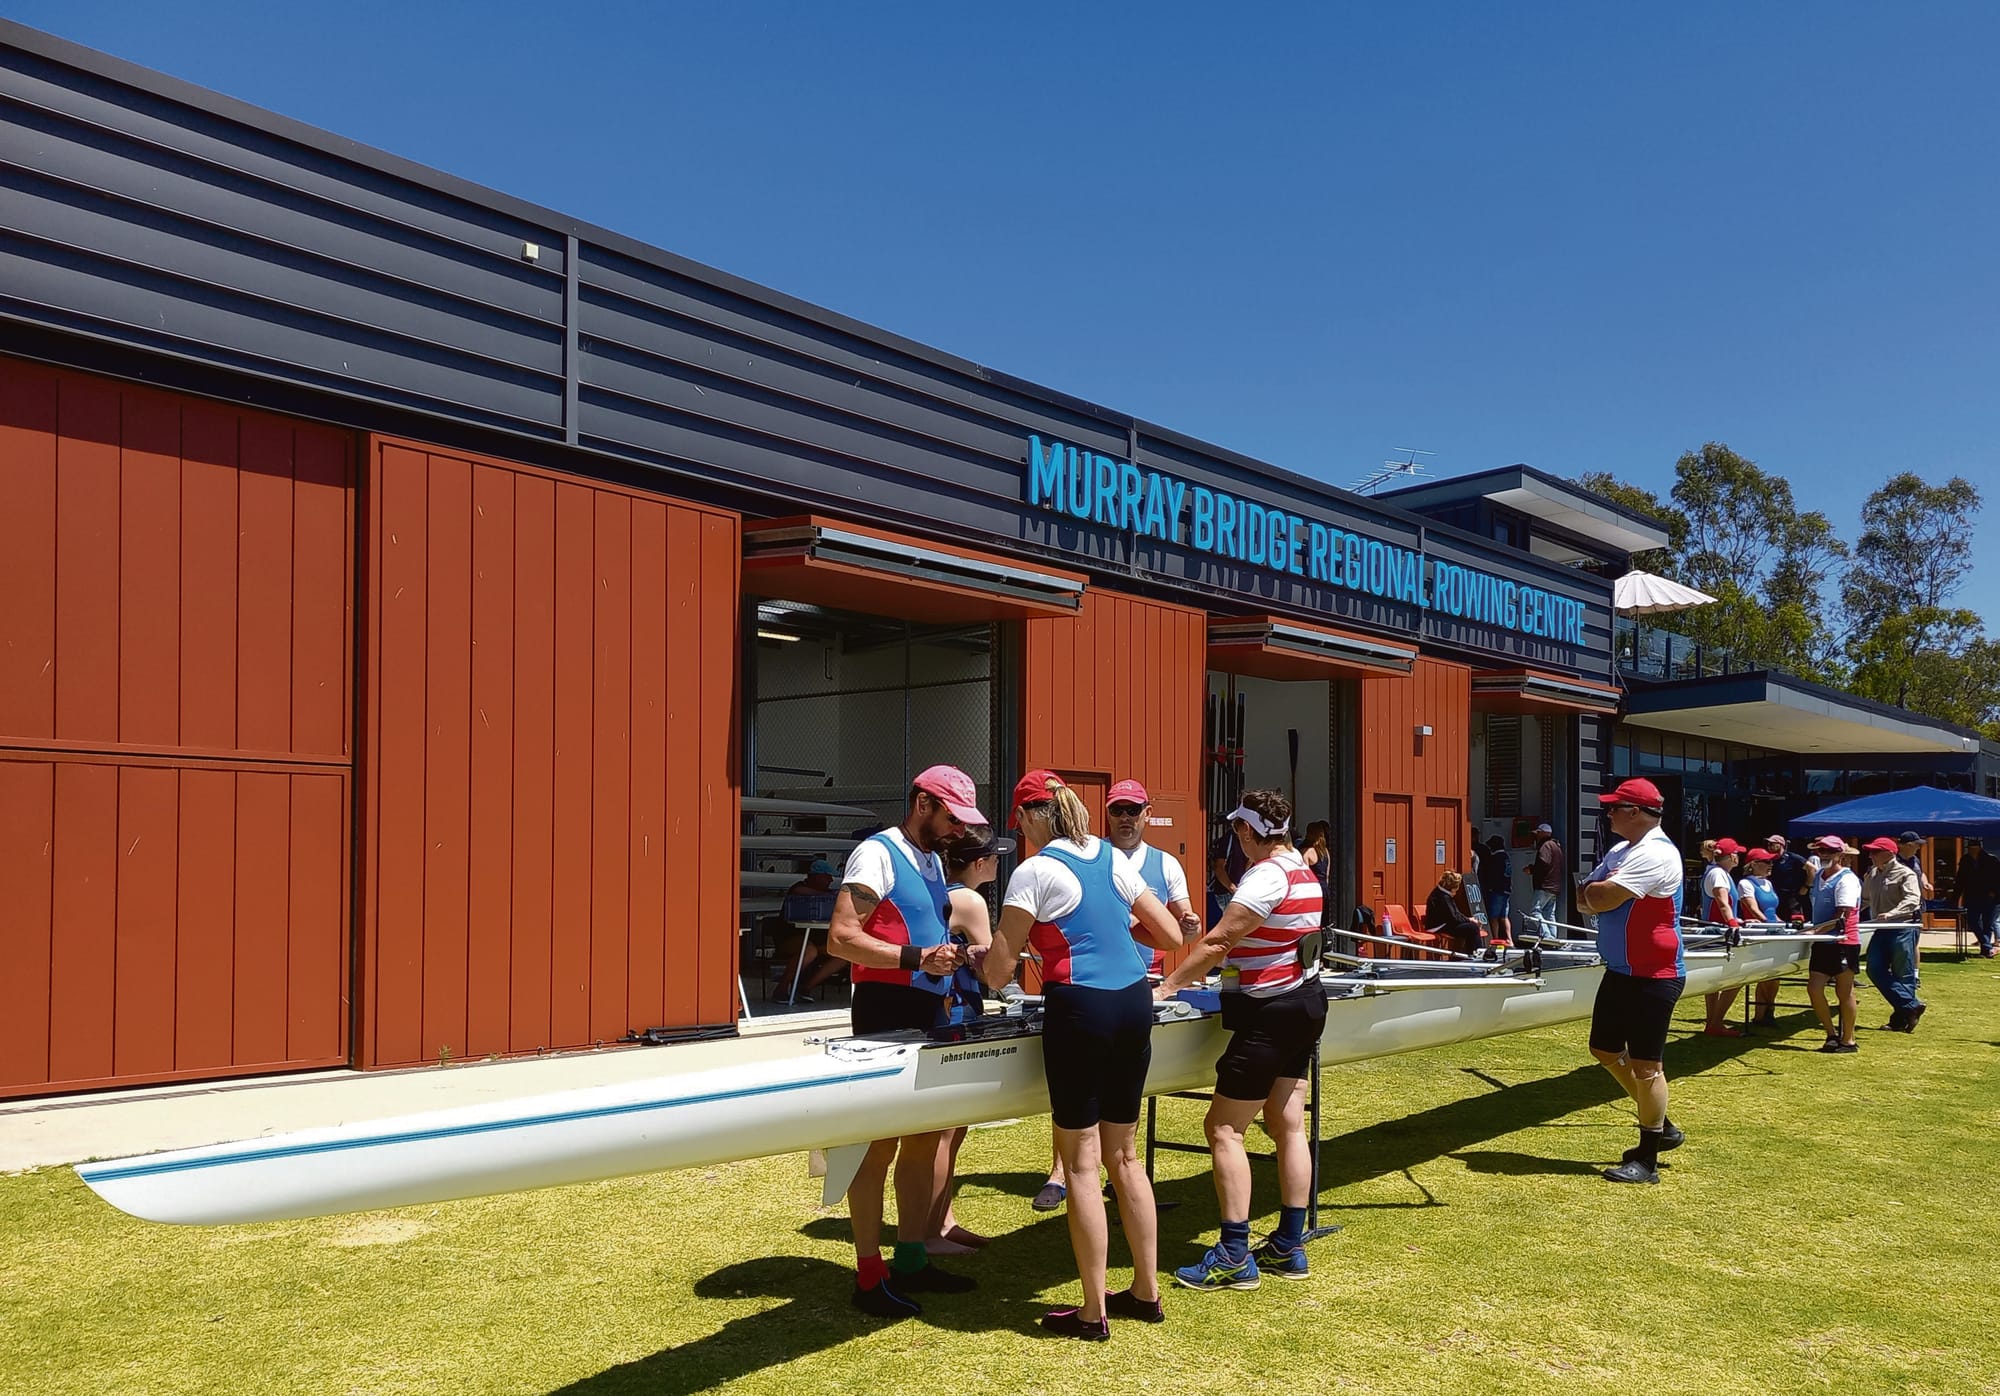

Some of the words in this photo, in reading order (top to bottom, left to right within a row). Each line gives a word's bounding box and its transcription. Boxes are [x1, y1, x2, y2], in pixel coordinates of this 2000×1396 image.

[1028, 435, 1185, 543] MURRAY
[1192, 486, 1303, 575] BRIDGE
[1308, 522, 1430, 607] REGIONAL
[1433, 560, 1517, 630] ROWING
[1519, 586, 1586, 646] CENTRE
[941, 1046, 1018, 1065] johnstonracing.com
